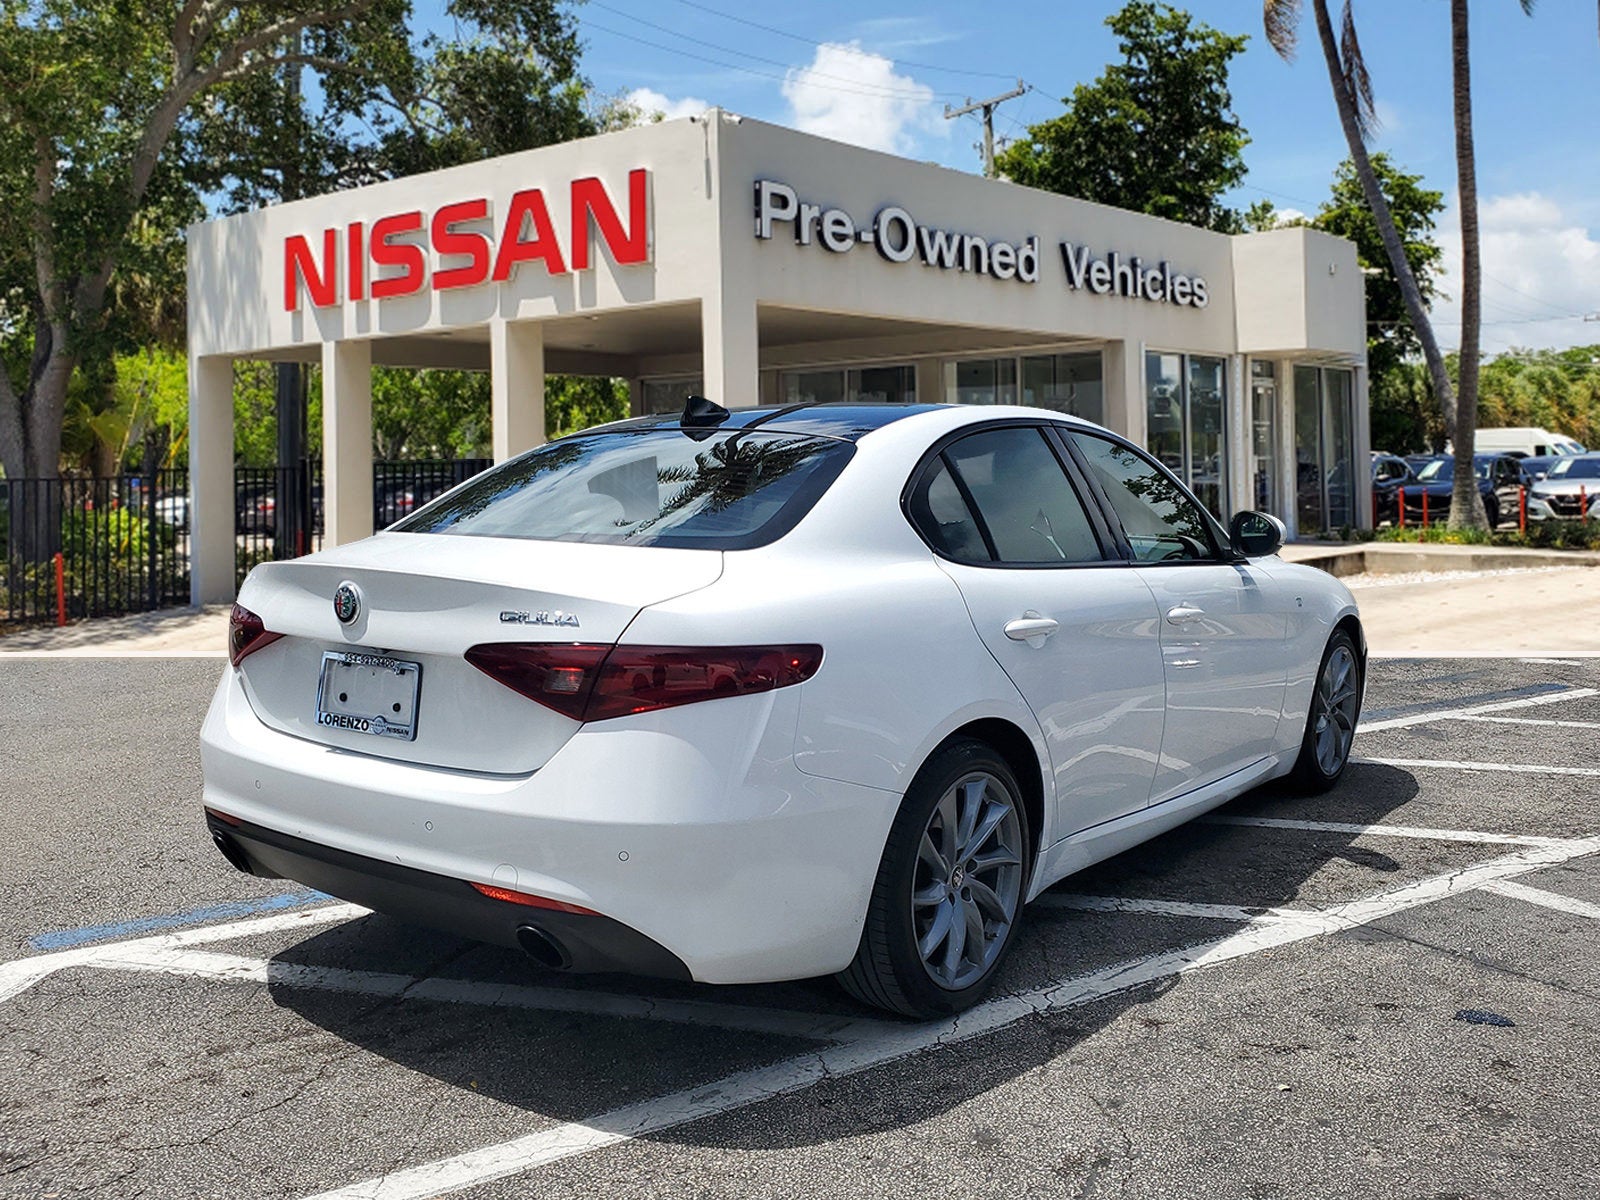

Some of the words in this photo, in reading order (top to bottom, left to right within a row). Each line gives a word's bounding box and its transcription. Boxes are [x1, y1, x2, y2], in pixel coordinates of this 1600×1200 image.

[284, 168, 648, 312] NISSAN
[755, 180, 1040, 284] Pre-Owned
[1060, 242, 1209, 308] Vehicles
[499, 610, 580, 628] GIULIA
[318, 712, 369, 731] LORENZO
[386, 727, 409, 736] NISSAN
